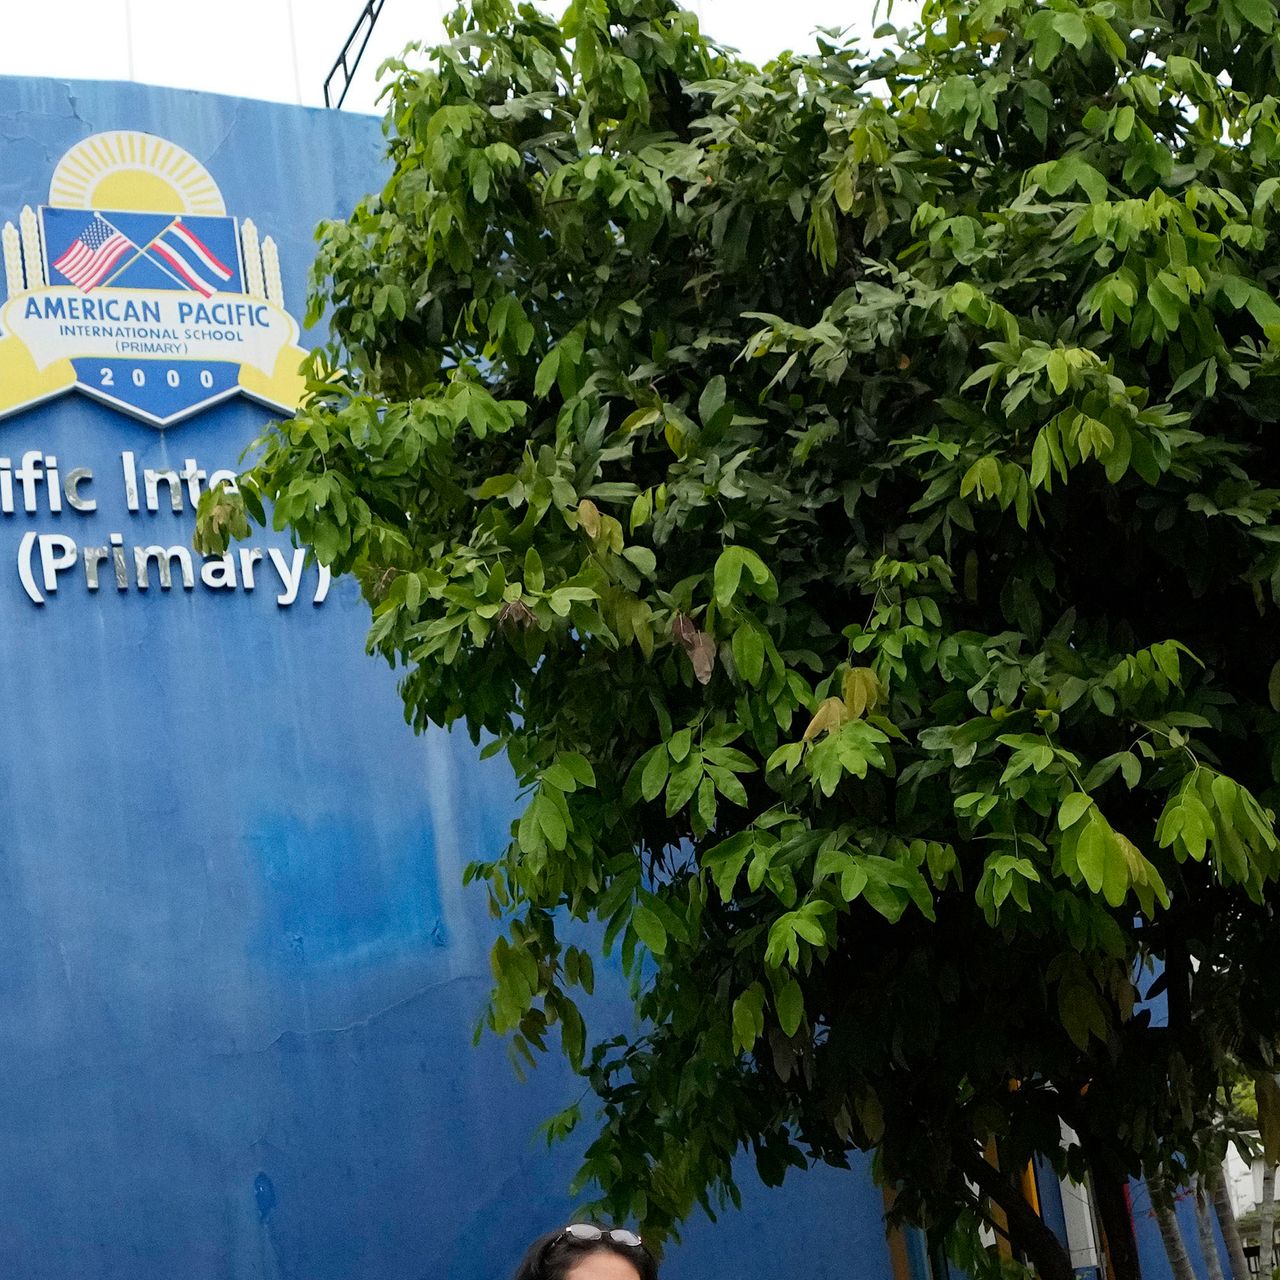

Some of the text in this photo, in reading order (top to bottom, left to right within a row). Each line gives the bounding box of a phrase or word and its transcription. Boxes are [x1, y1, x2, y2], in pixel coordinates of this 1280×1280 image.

[24, 296, 270, 328] AMERICAN PACIFIC
[59, 324, 244, 342] INTERNATIONAL SCHOOL
[115, 341, 188, 354] (PRIMARY)
[100, 367, 214, 388] 2000
[17, 531, 332, 605] (Primary)
